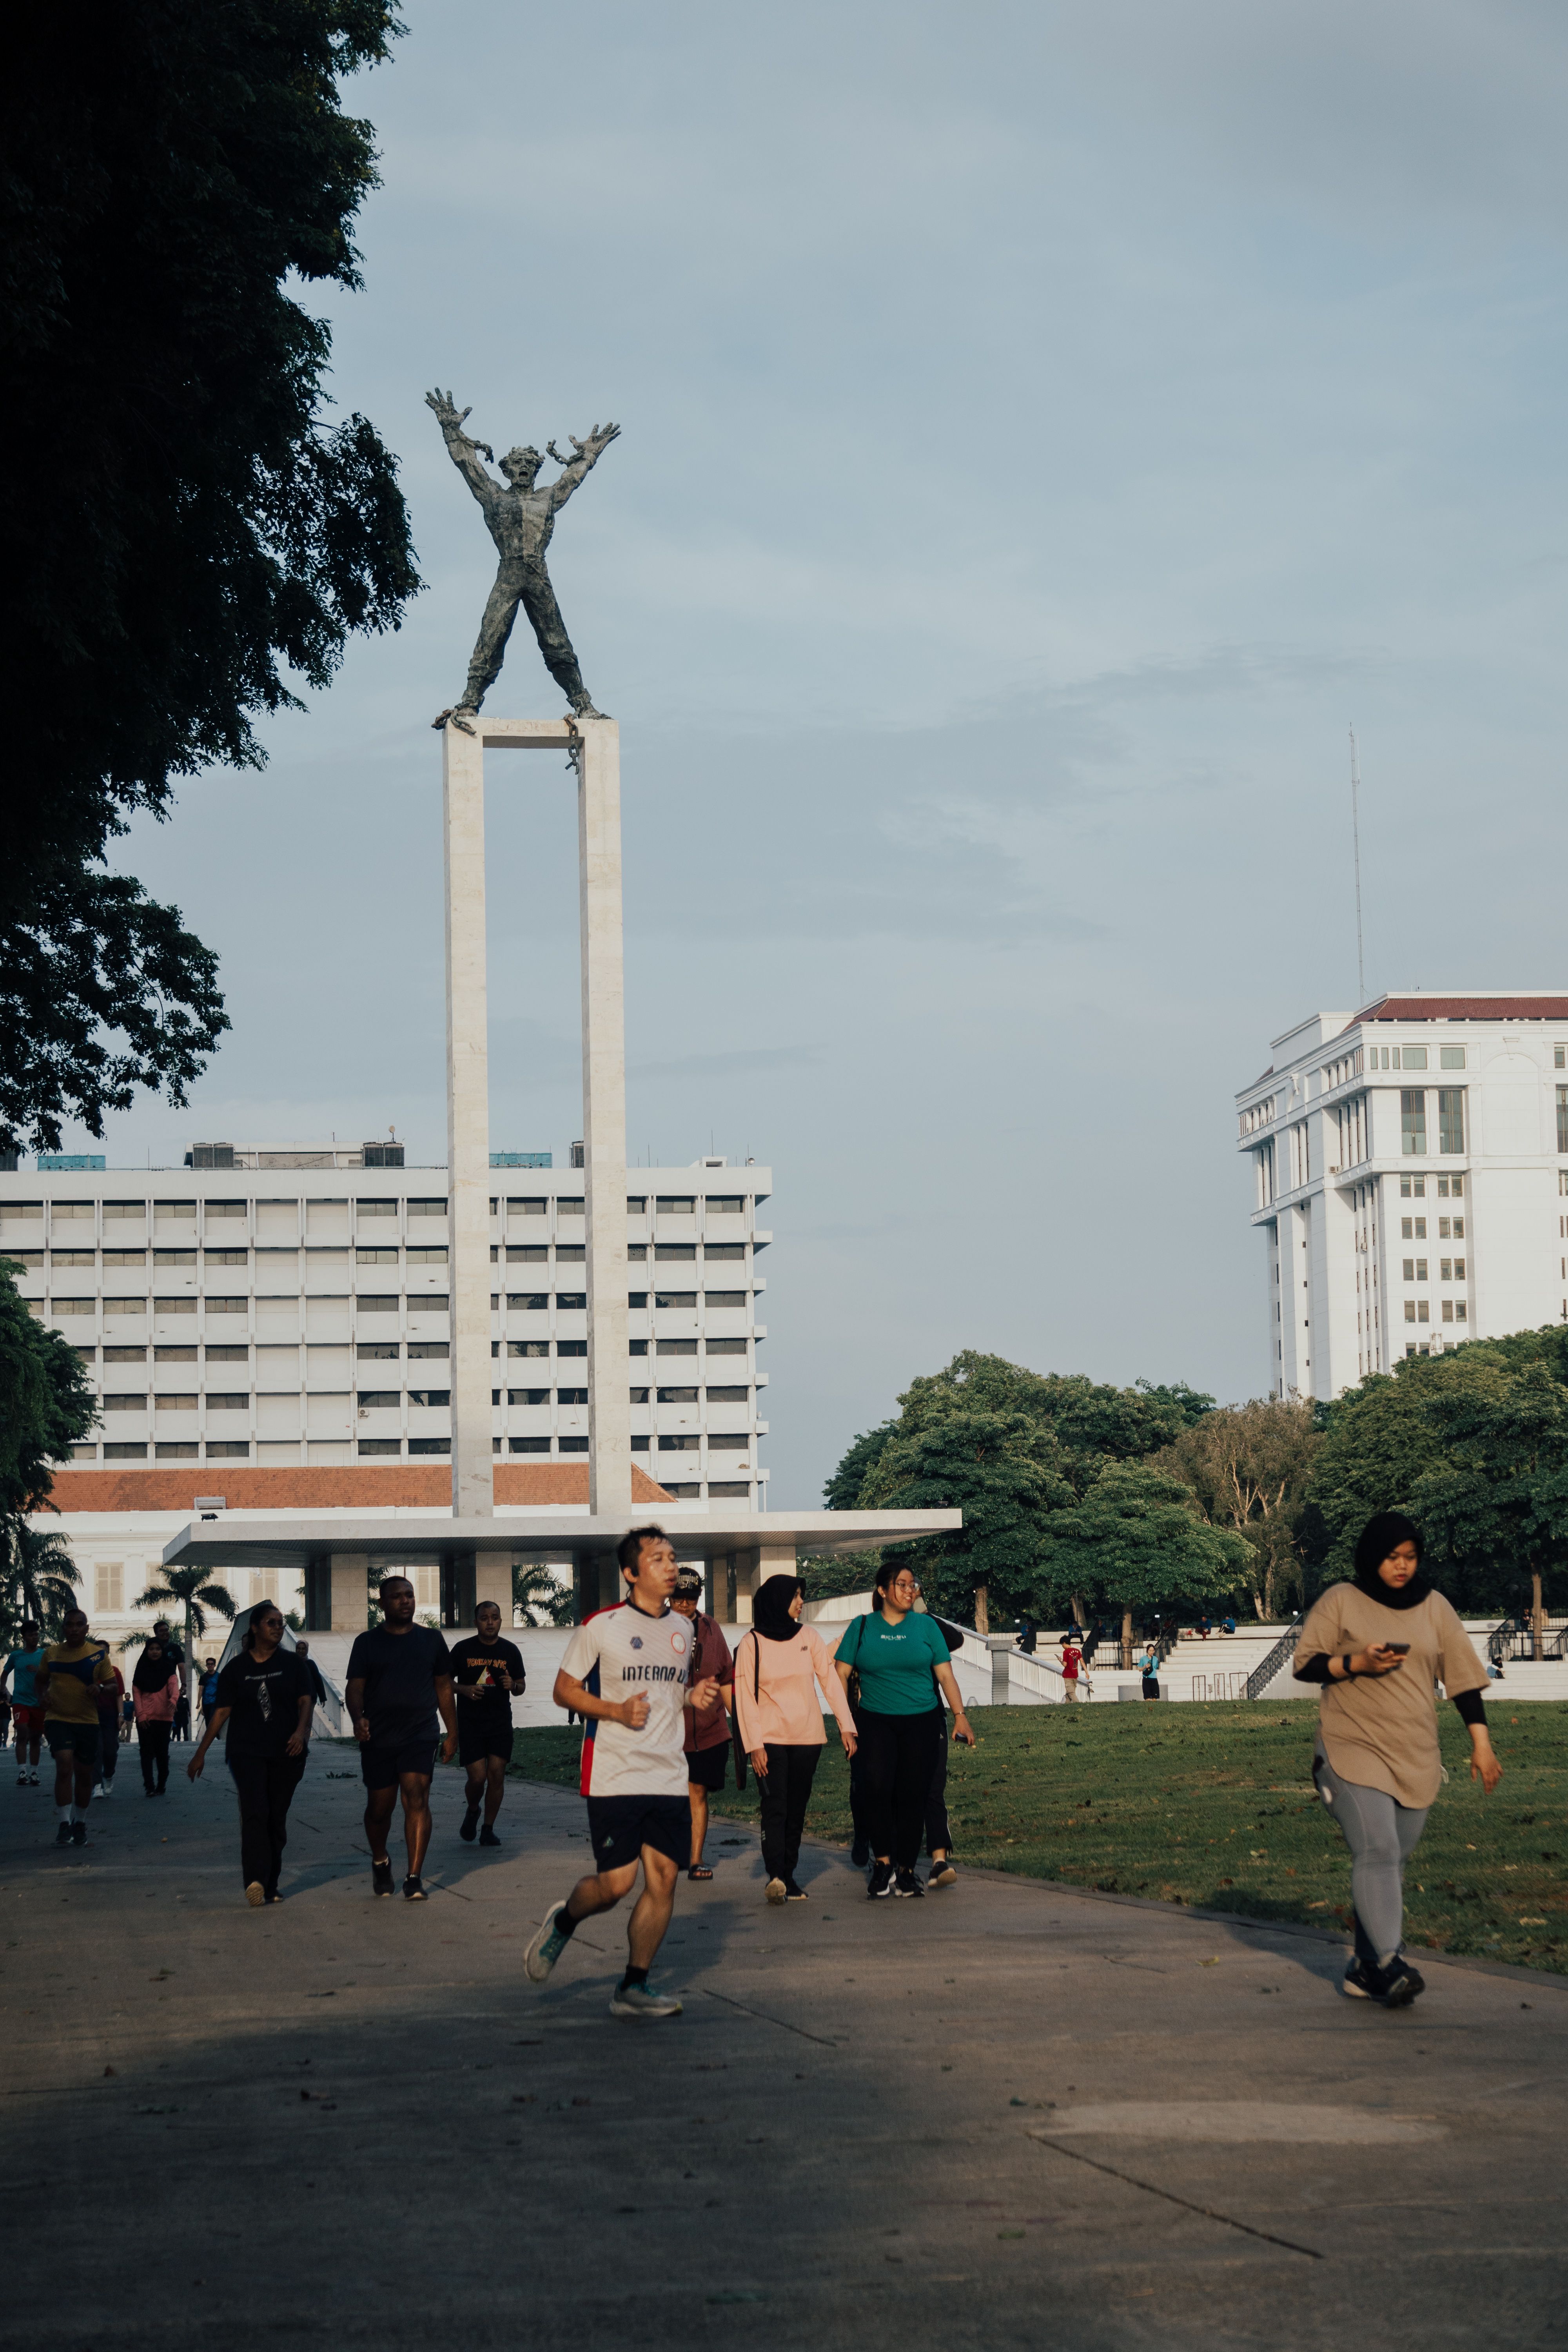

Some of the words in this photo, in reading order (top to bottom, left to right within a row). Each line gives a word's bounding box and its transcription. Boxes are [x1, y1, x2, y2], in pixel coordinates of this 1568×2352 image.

[677, 1573, 699, 1586] hampions
[467, 1658, 492, 1668] YONKAV
[493, 1660, 506, 1670] 2/TC
